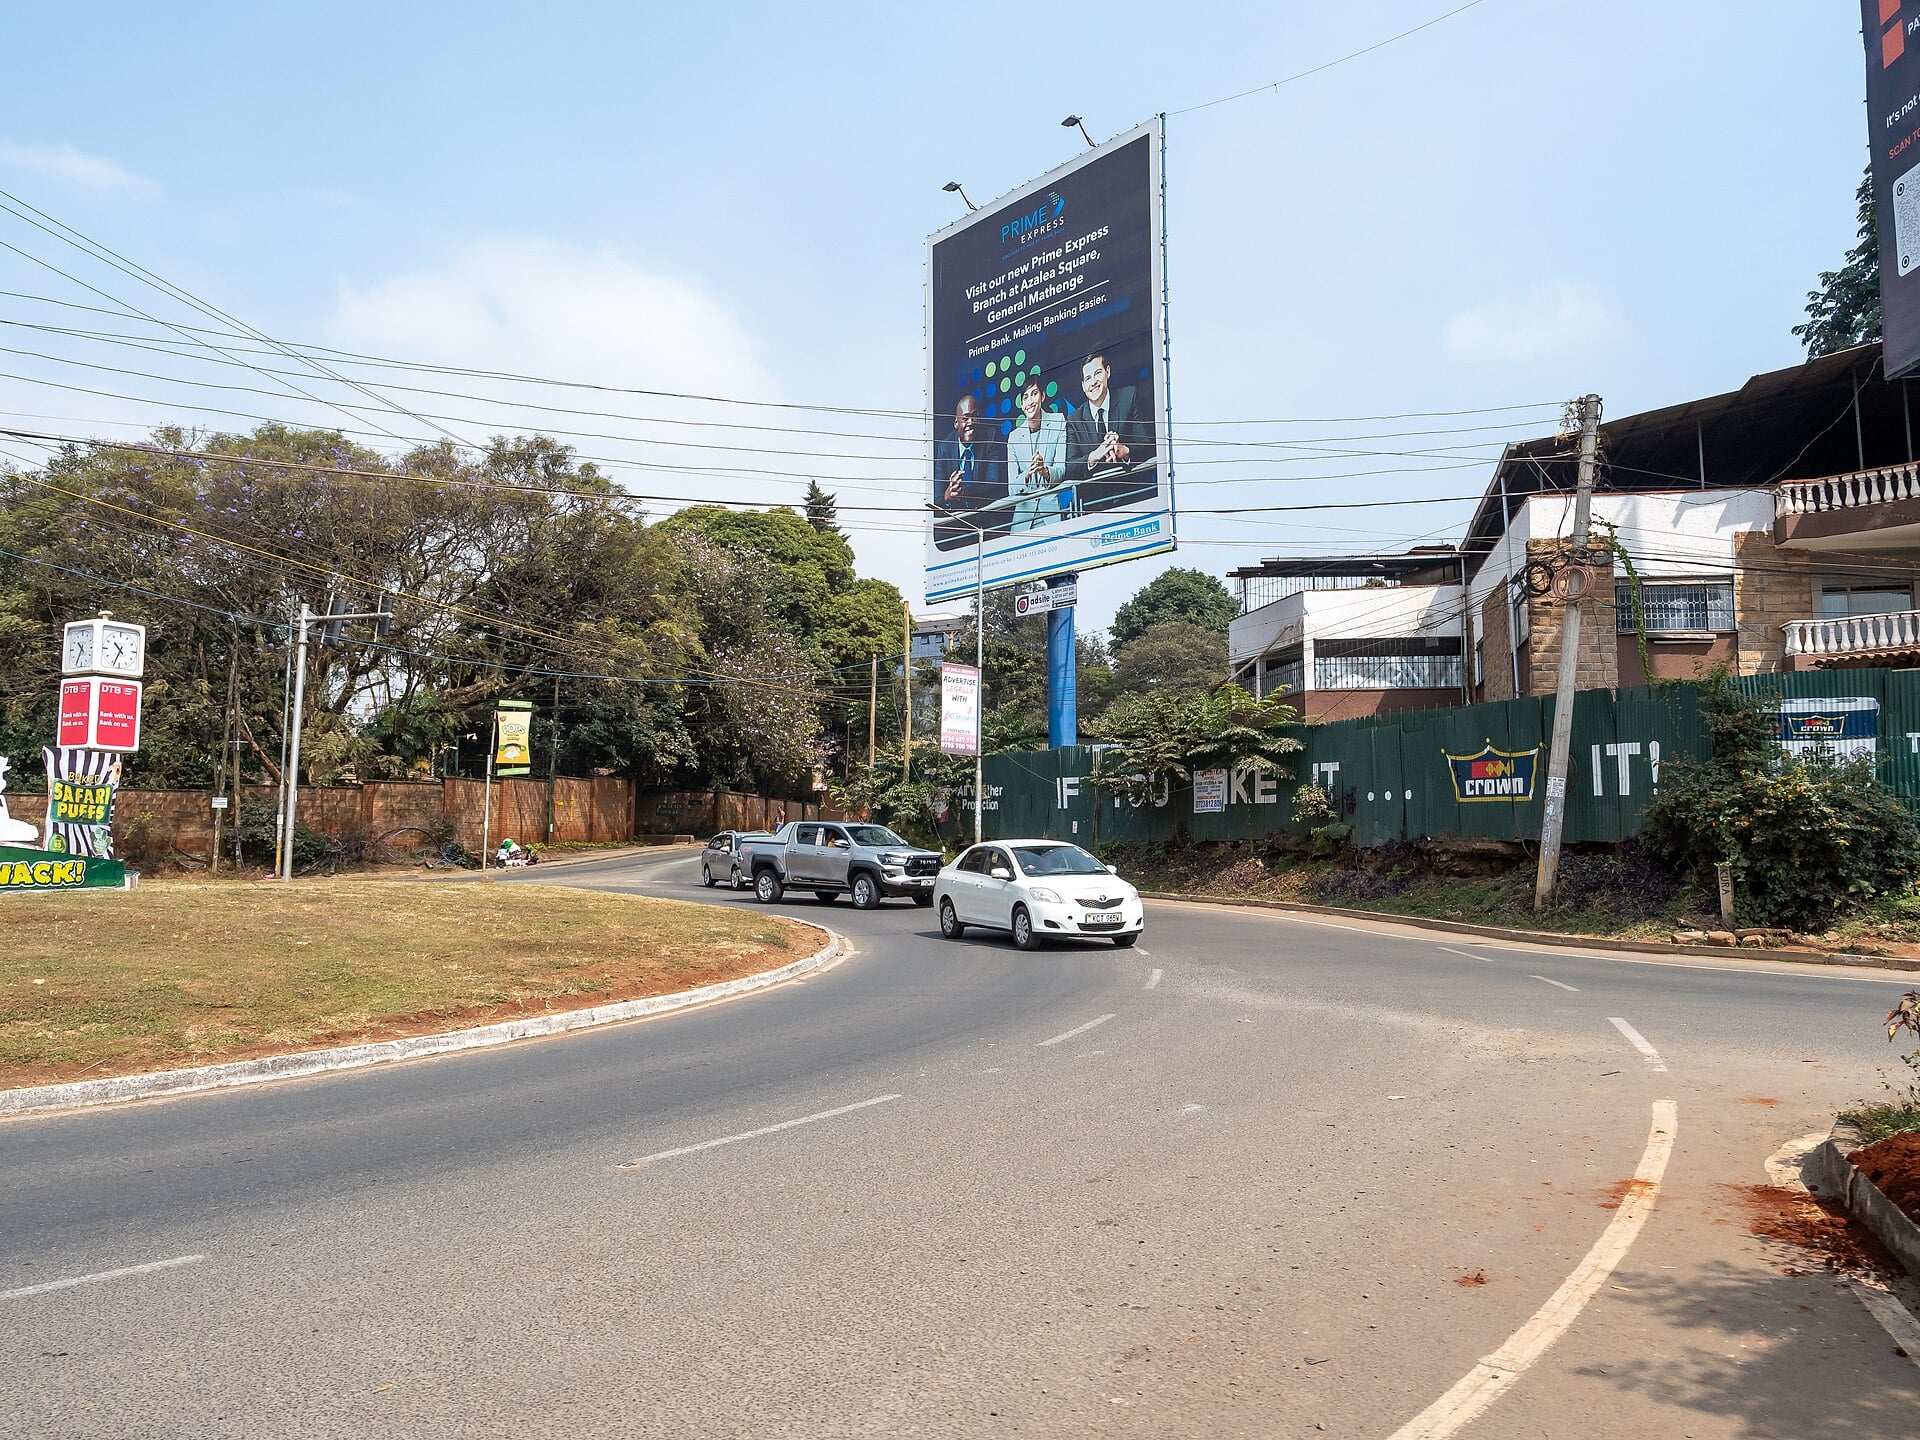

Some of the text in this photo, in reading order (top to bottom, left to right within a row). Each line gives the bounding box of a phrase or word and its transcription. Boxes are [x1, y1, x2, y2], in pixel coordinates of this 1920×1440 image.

[1886, 94, 1917, 128] It's not
[1889, 135, 1911, 159] SCAN
[1001, 205, 1048, 243] PRIME
[1020, 216, 1064, 244] EXPRESS
[965, 225, 1109, 300] Visit our new Prime Express
[973, 250, 1100, 313] Branch at Azalea Square,
[987, 274, 1084, 323] General Mathenge
[968, 294, 1107, 358] Prime Bank. Making Banking Easier.
[1104, 523, 1158, 542] Prime Bank
[1030, 593, 1050, 605] adsite
[64, 685, 79, 694] DTB
[101, 684, 122, 694] DTB
[943, 675, 976, 686] ADVERTISE
[952, 695, 967, 703] WITH
[68, 771, 101, 785] BAKED
[1591, 740, 1660, 796] IT!
[53, 782, 111, 805] SAFARI
[1056, 776, 1080, 809] IF
[1222, 768, 1277, 804] IKE
[1465, 777, 1524, 796] crown
[57, 802, 105, 820] PUFFS
[962, 798, 999, 811] Proction
[1719, 867, 1731, 896] KURA
